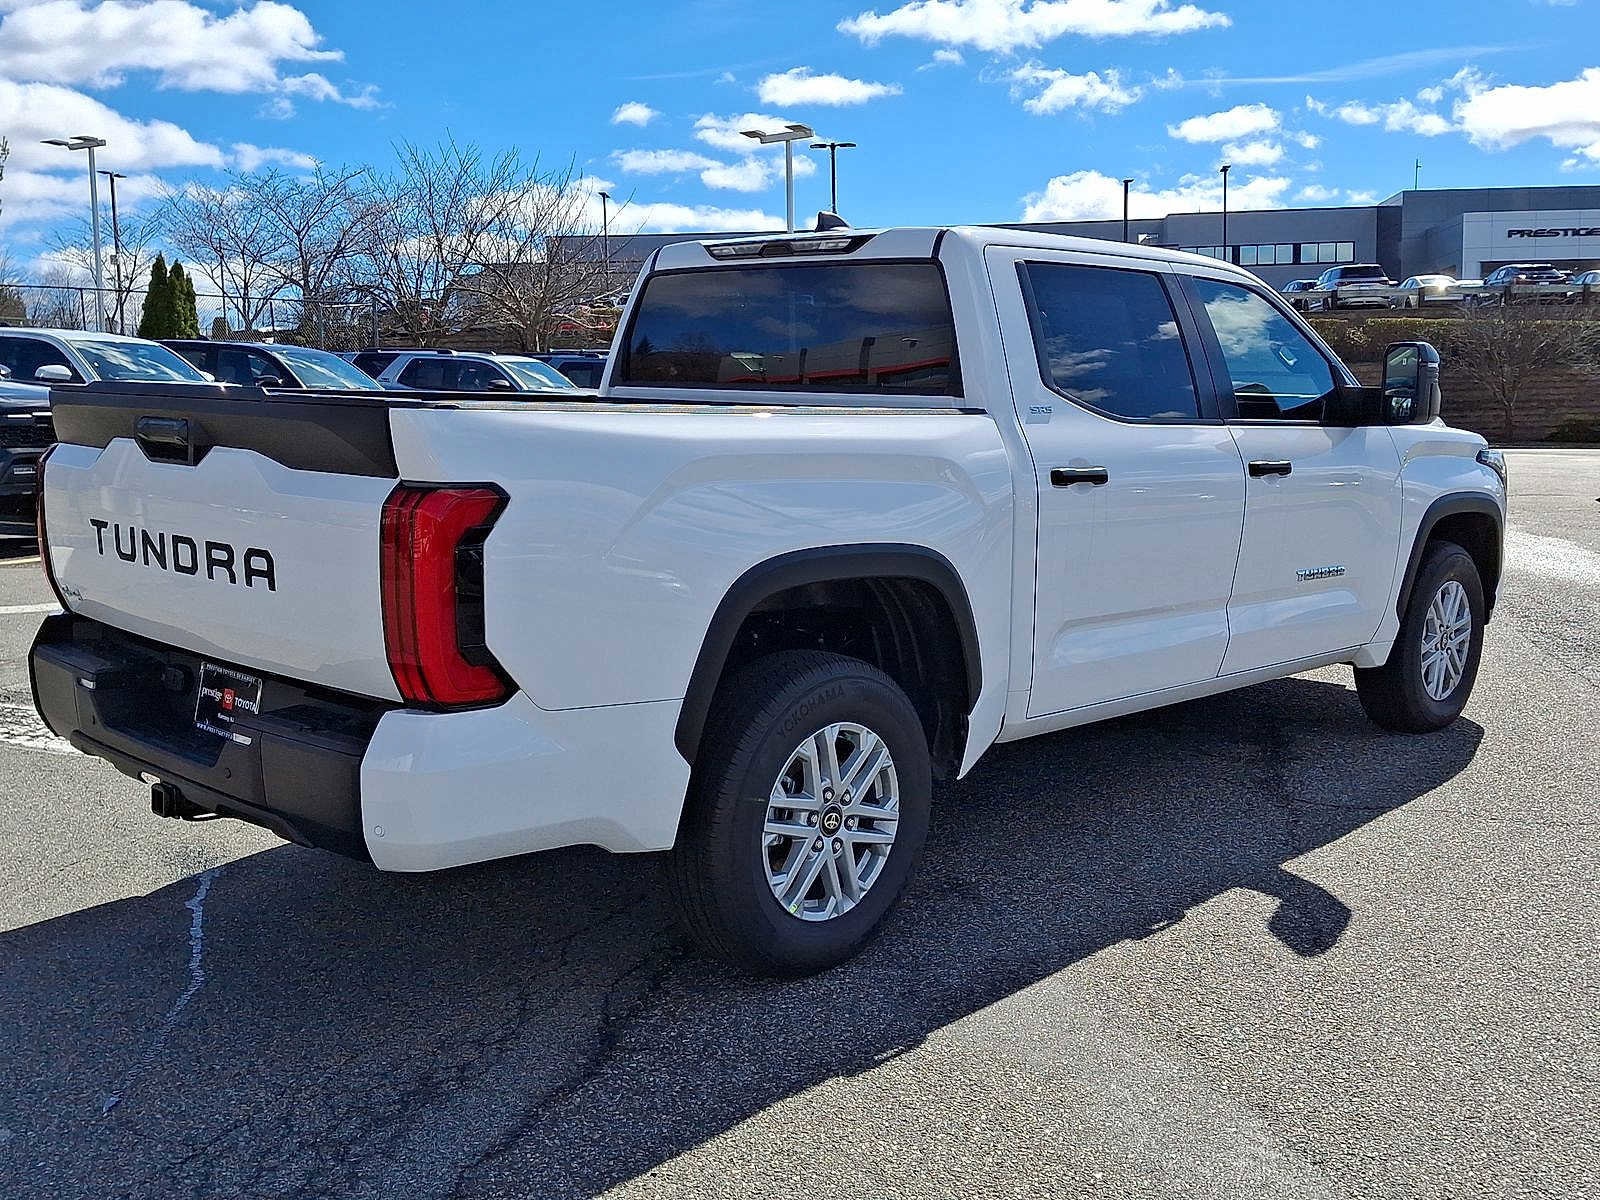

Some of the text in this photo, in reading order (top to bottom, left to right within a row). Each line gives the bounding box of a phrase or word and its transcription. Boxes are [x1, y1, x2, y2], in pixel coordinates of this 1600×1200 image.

[1507, 227, 1600, 238] PRESTIGE
[89, 518, 277, 592] TUNDRA
[1296, 566, 1345, 582] TUNDRA
[201, 687, 222, 702] prestige
[234, 697, 258, 713] TOYOTA
[776, 686, 846, 739] YOKOHAMA
